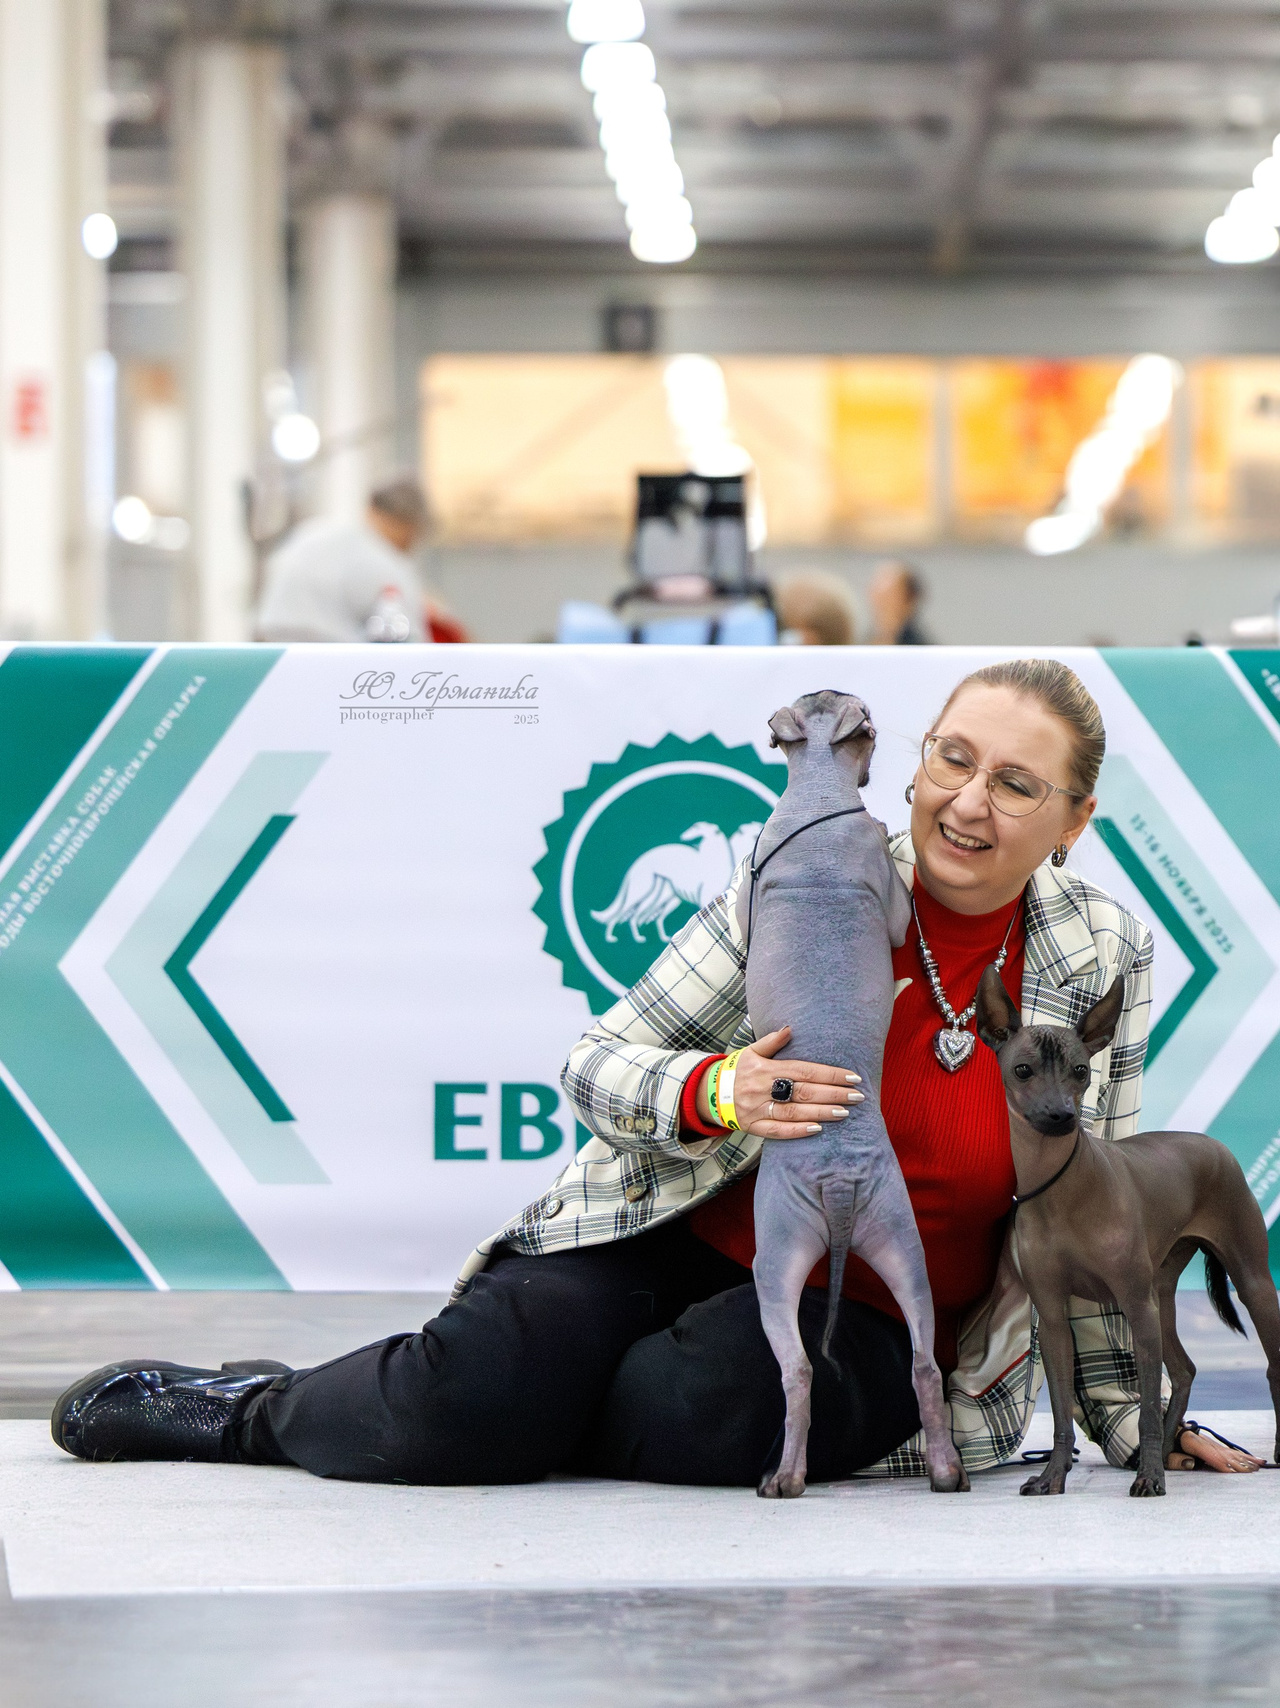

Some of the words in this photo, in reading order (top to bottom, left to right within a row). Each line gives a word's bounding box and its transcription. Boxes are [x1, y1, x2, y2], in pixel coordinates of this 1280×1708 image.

[153, 675, 207, 740] ОВЧАРКА
[18, 817, 79, 891] ВЫСТАВКА
[77, 766, 116, 814] СОБАК
[1130, 814, 1160, 853] 15-16
[1159, 855, 1207, 916] НОЯБРЯ
[1203, 917, 1234, 954] 2025
[434, 1083, 595, 1160] ЕВ
